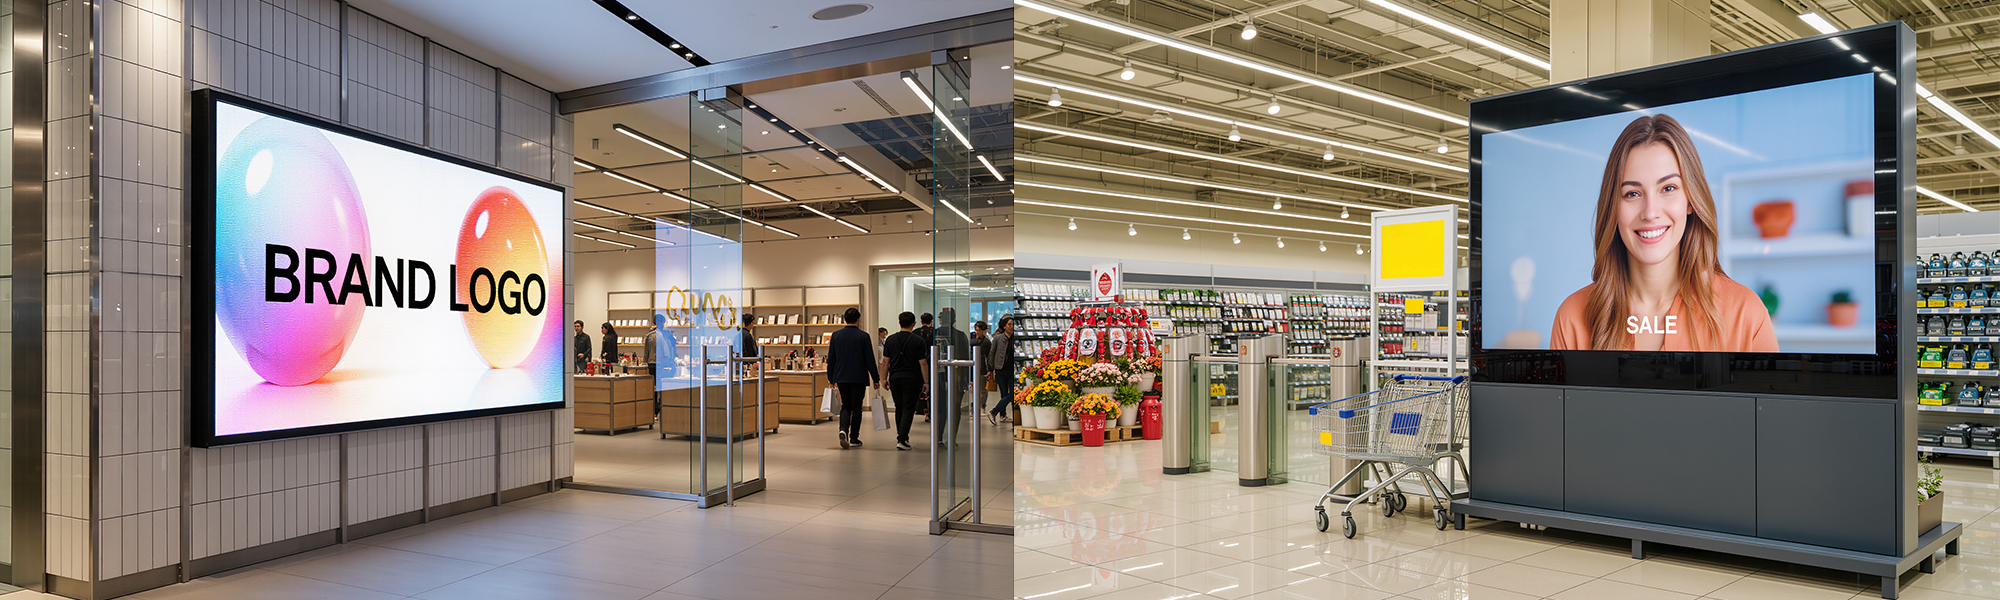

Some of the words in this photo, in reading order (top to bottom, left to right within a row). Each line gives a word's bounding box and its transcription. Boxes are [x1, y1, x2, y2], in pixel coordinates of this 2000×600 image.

[265, 243, 436, 309] BRAND
[449, 264, 546, 316] LOGO
[1627, 315, 1677, 334] SALE
